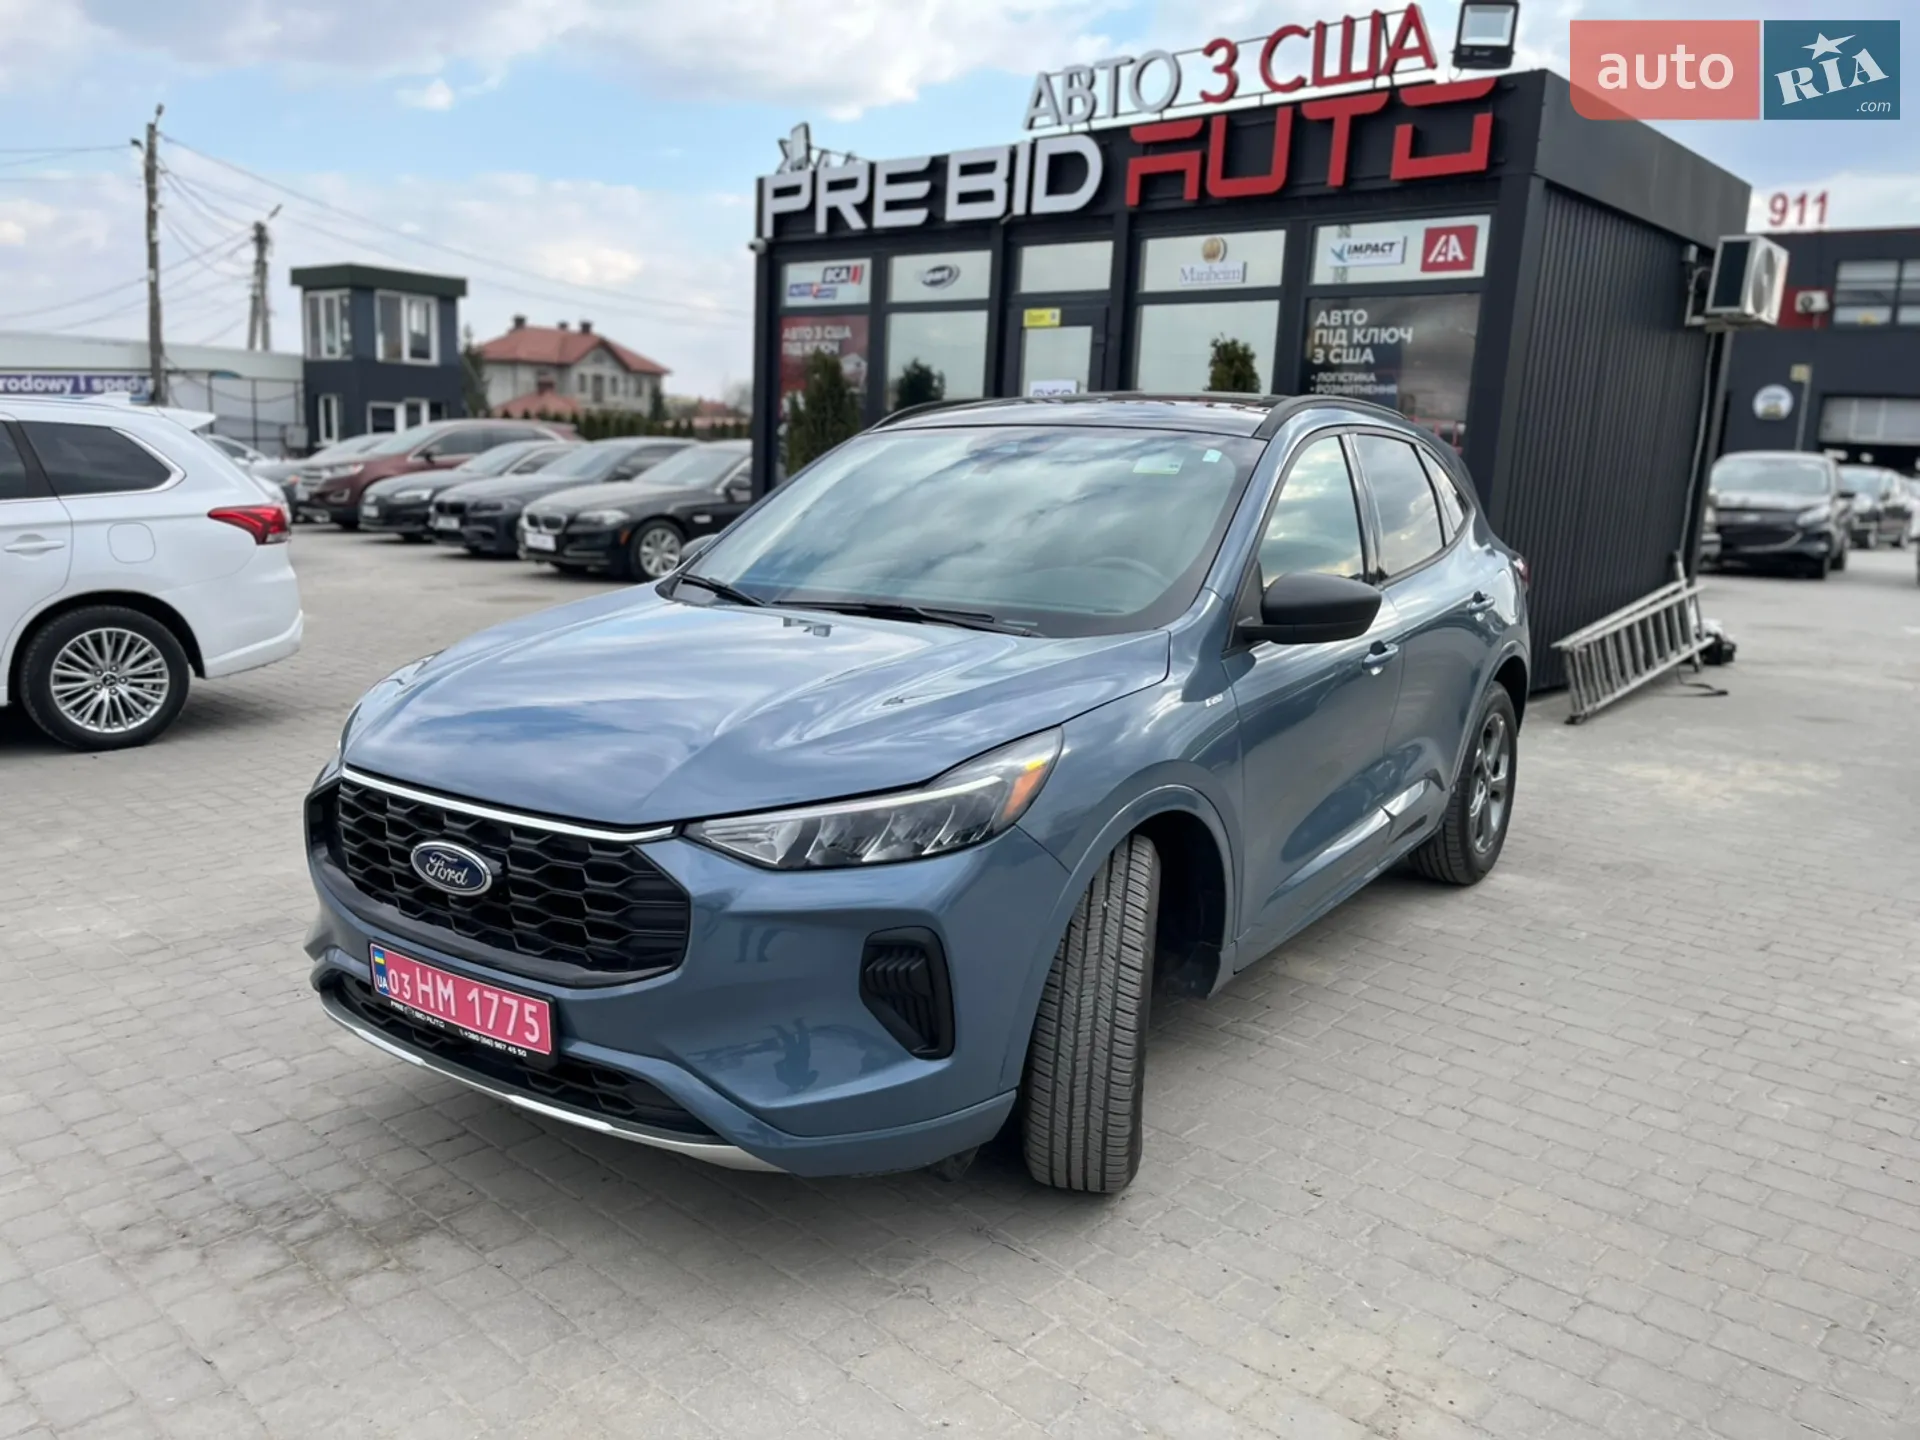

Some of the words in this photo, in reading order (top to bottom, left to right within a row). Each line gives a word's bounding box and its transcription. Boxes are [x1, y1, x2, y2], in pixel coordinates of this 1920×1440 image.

[1023, 49, 1181, 131] АВТО
[1259, 3, 1438, 94] США
[757, 155, 932, 239] PRE
[945, 133, 1104, 222] BID
[1125, 77, 1498, 207] AUTO
[1768, 190, 1830, 228] 911
[1347, 242, 1396, 255] IMPACT
[1179, 266, 1242, 284] Manheim
[1315, 309, 1368, 326] АВТО
[1314, 329, 1348, 346] ПІД
[1352, 327, 1414, 344] КЛЮЧ
[1328, 347, 1375, 364] США
[425, 851, 469, 886] Ford
[376, 974, 389, 990] UA
[389, 968, 412, 1000] 03
[415, 966, 456, 1017] HM
[466, 987, 541, 1044] 1775
